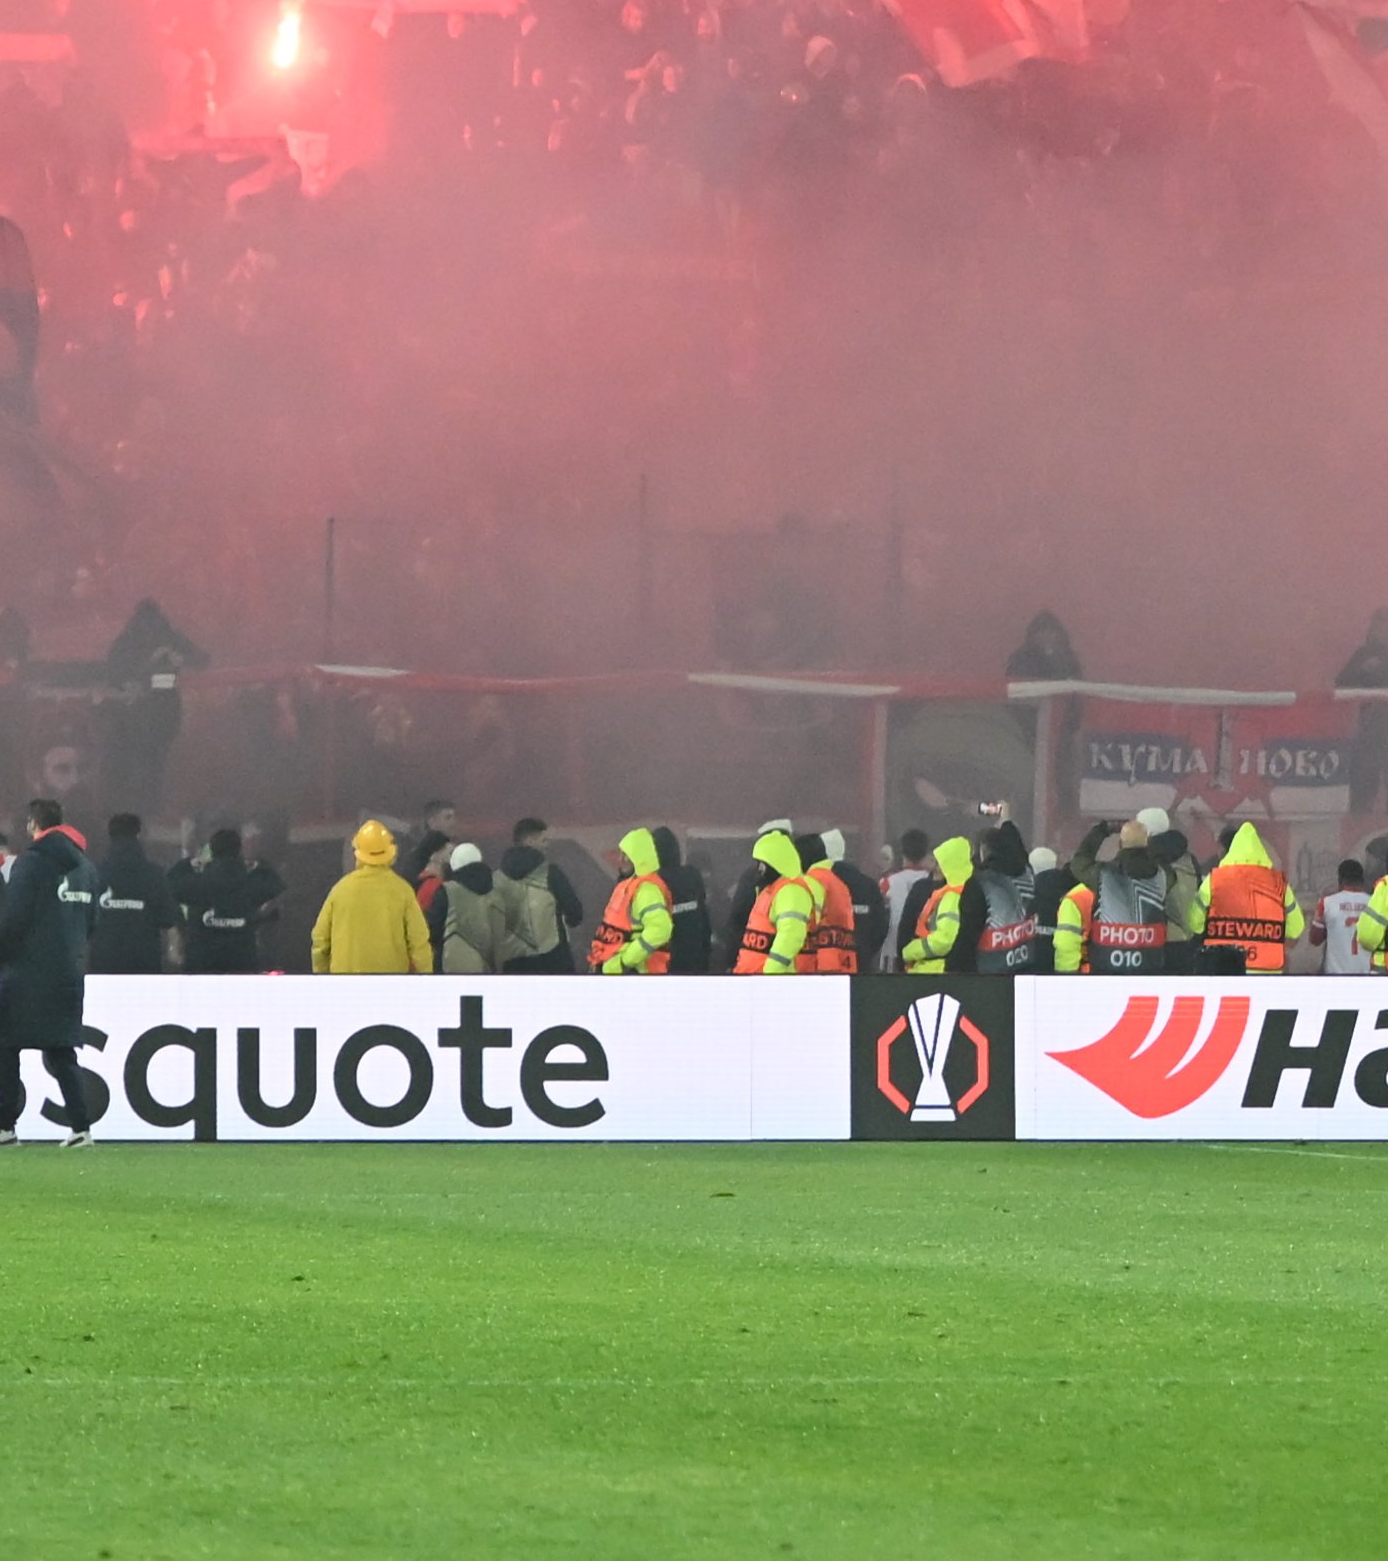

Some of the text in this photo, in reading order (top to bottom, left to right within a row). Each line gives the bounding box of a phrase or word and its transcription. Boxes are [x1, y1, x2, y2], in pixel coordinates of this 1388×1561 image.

[1099, 927, 1154, 945] PHOTO
[1206, 919, 1283, 940] STEWARD
[1110, 951, 1142, 968] 010
